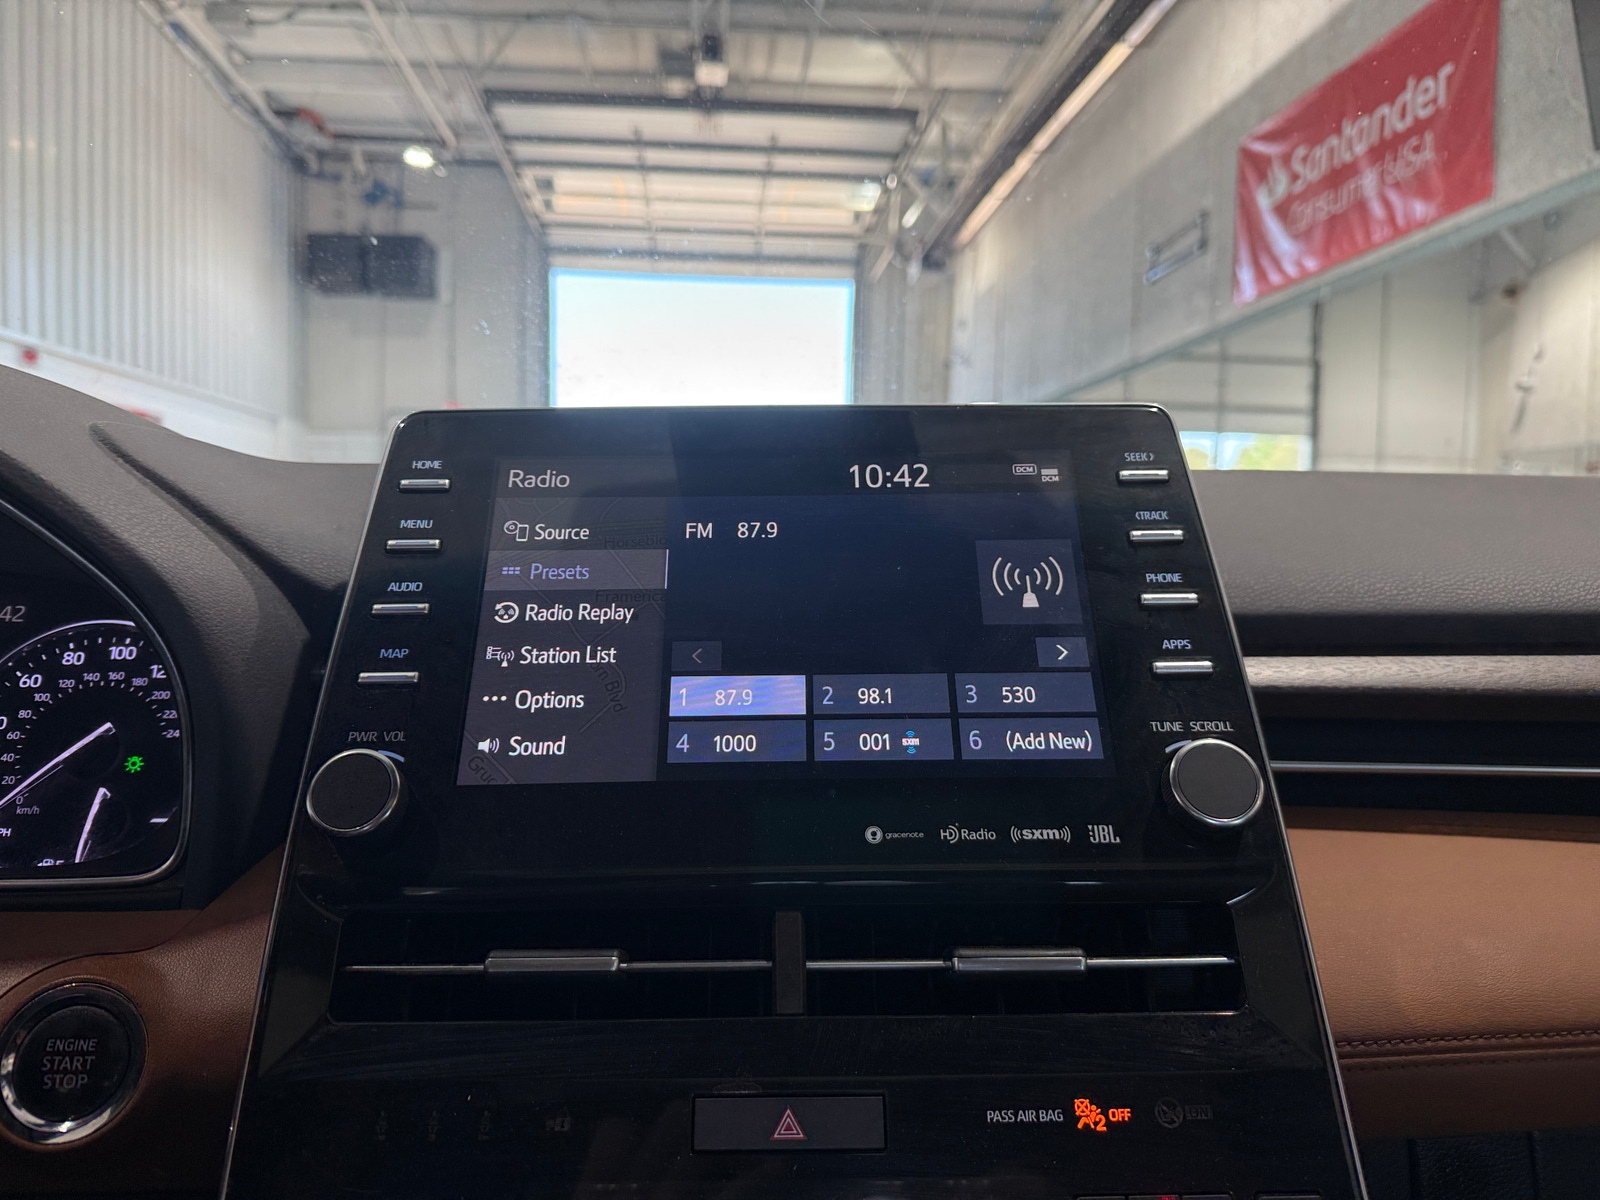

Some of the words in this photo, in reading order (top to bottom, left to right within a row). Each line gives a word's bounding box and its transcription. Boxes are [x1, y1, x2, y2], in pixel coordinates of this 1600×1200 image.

[1289, 61, 1456, 195] Santander
[1383, 130, 1435, 186] USA
[1124, 452, 1148, 462] SEEK
[412, 460, 442, 470] HOME
[507, 469, 570, 489] Radio
[849, 463, 930, 488] 10:42
[1139, 510, 1168, 520] TRACK
[400, 519, 433, 529] MENU
[685, 522, 713, 539] FM
[737, 521, 778, 539] 87.9
[534, 523, 590, 541] Source
[529, 563, 590, 581] Presets
[1145, 572, 1183, 583] PHONE
[388, 582, 423, 592] AUDIO
[525, 603, 573, 621] Radio
[578, 603, 635, 624] Replay
[1162, 639, 1192, 649] APPS
[62, 652, 85, 666] 80
[109, 646, 137, 660] 100
[380, 649, 408, 659] MAP
[519, 646, 580, 664] Station
[586, 645, 617, 663] List
[83, 672, 100, 682] 140
[108, 671, 125, 680] 160
[150, 664, 167, 678] 12
[19, 674, 42, 688] 60
[58, 679, 75, 688] 120
[131, 677, 148, 686] 180
[33, 693, 51, 702] 100
[151, 691, 171, 699] 200
[679, 687, 687, 706] 1
[715, 689, 753, 706] 87.9
[822, 686, 834, 705] 2
[857, 687, 893, 704] 98.1
[965, 684, 978, 703] 3
[1002, 686, 1036, 703] 530
[515, 690, 584, 713] Options
[18, 709, 32, 719] 80
[163, 710, 178, 719] 22
[1150, 721, 1184, 732] TUNE
[1190, 721, 1234, 732] SCROLL
[6, 731, 20, 740] 60
[166, 729, 180, 738] 24
[348, 731, 378, 742] PWR
[384, 731, 406, 742] VOL
[508, 736, 566, 756] Sound
[676, 733, 689, 753] 4
[713, 734, 757, 752] 1000
[823, 731, 835, 751] 5
[859, 733, 890, 751] 001
[969, 730, 982, 750] 6
[1006, 730, 1046, 752] (Add
[1049, 729, 1092, 752] New)
[0, 753, 14, 762] 40
[1, 776, 15, 785] 20
[16, 806, 39, 815] km/h
[885, 831, 925, 840] gracenote
[961, 828, 996, 840] Radio
[1022, 828, 1060, 840] sxm
[1088, 824, 1121, 843] JBL
[46, 1039, 98, 1052] ENGINE
[41, 1056, 96, 1071] START
[42, 1074, 88, 1089] STOP
[987, 1110, 1015, 1123] PASS
[1017, 1110, 1037, 1122] AIR
[1039, 1109, 1063, 1122] BAG
[1108, 1108, 1131, 1121] OFF
